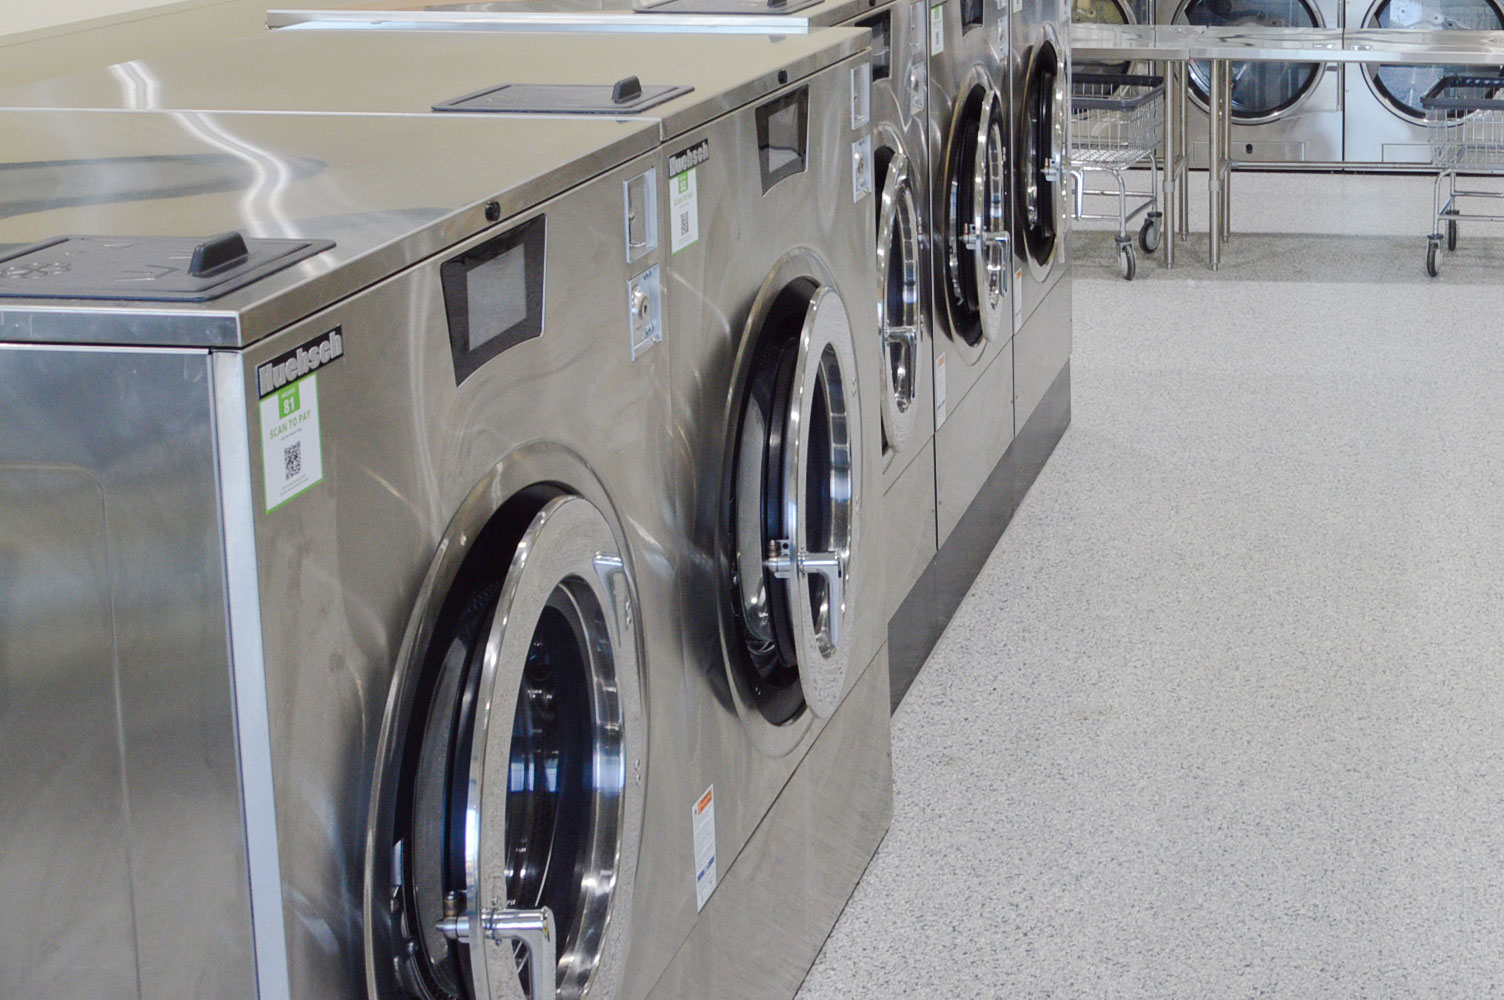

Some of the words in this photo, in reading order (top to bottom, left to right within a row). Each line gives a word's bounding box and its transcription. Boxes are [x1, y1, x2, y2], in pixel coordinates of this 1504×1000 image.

[669, 141, 709, 176] Huebsch
[259, 331, 343, 396] Huebsch
[284, 397, 295, 414] 81
[270, 422, 287, 439] SCAN
[289, 417, 297, 428] TO
[299, 410, 311, 424] PAY
